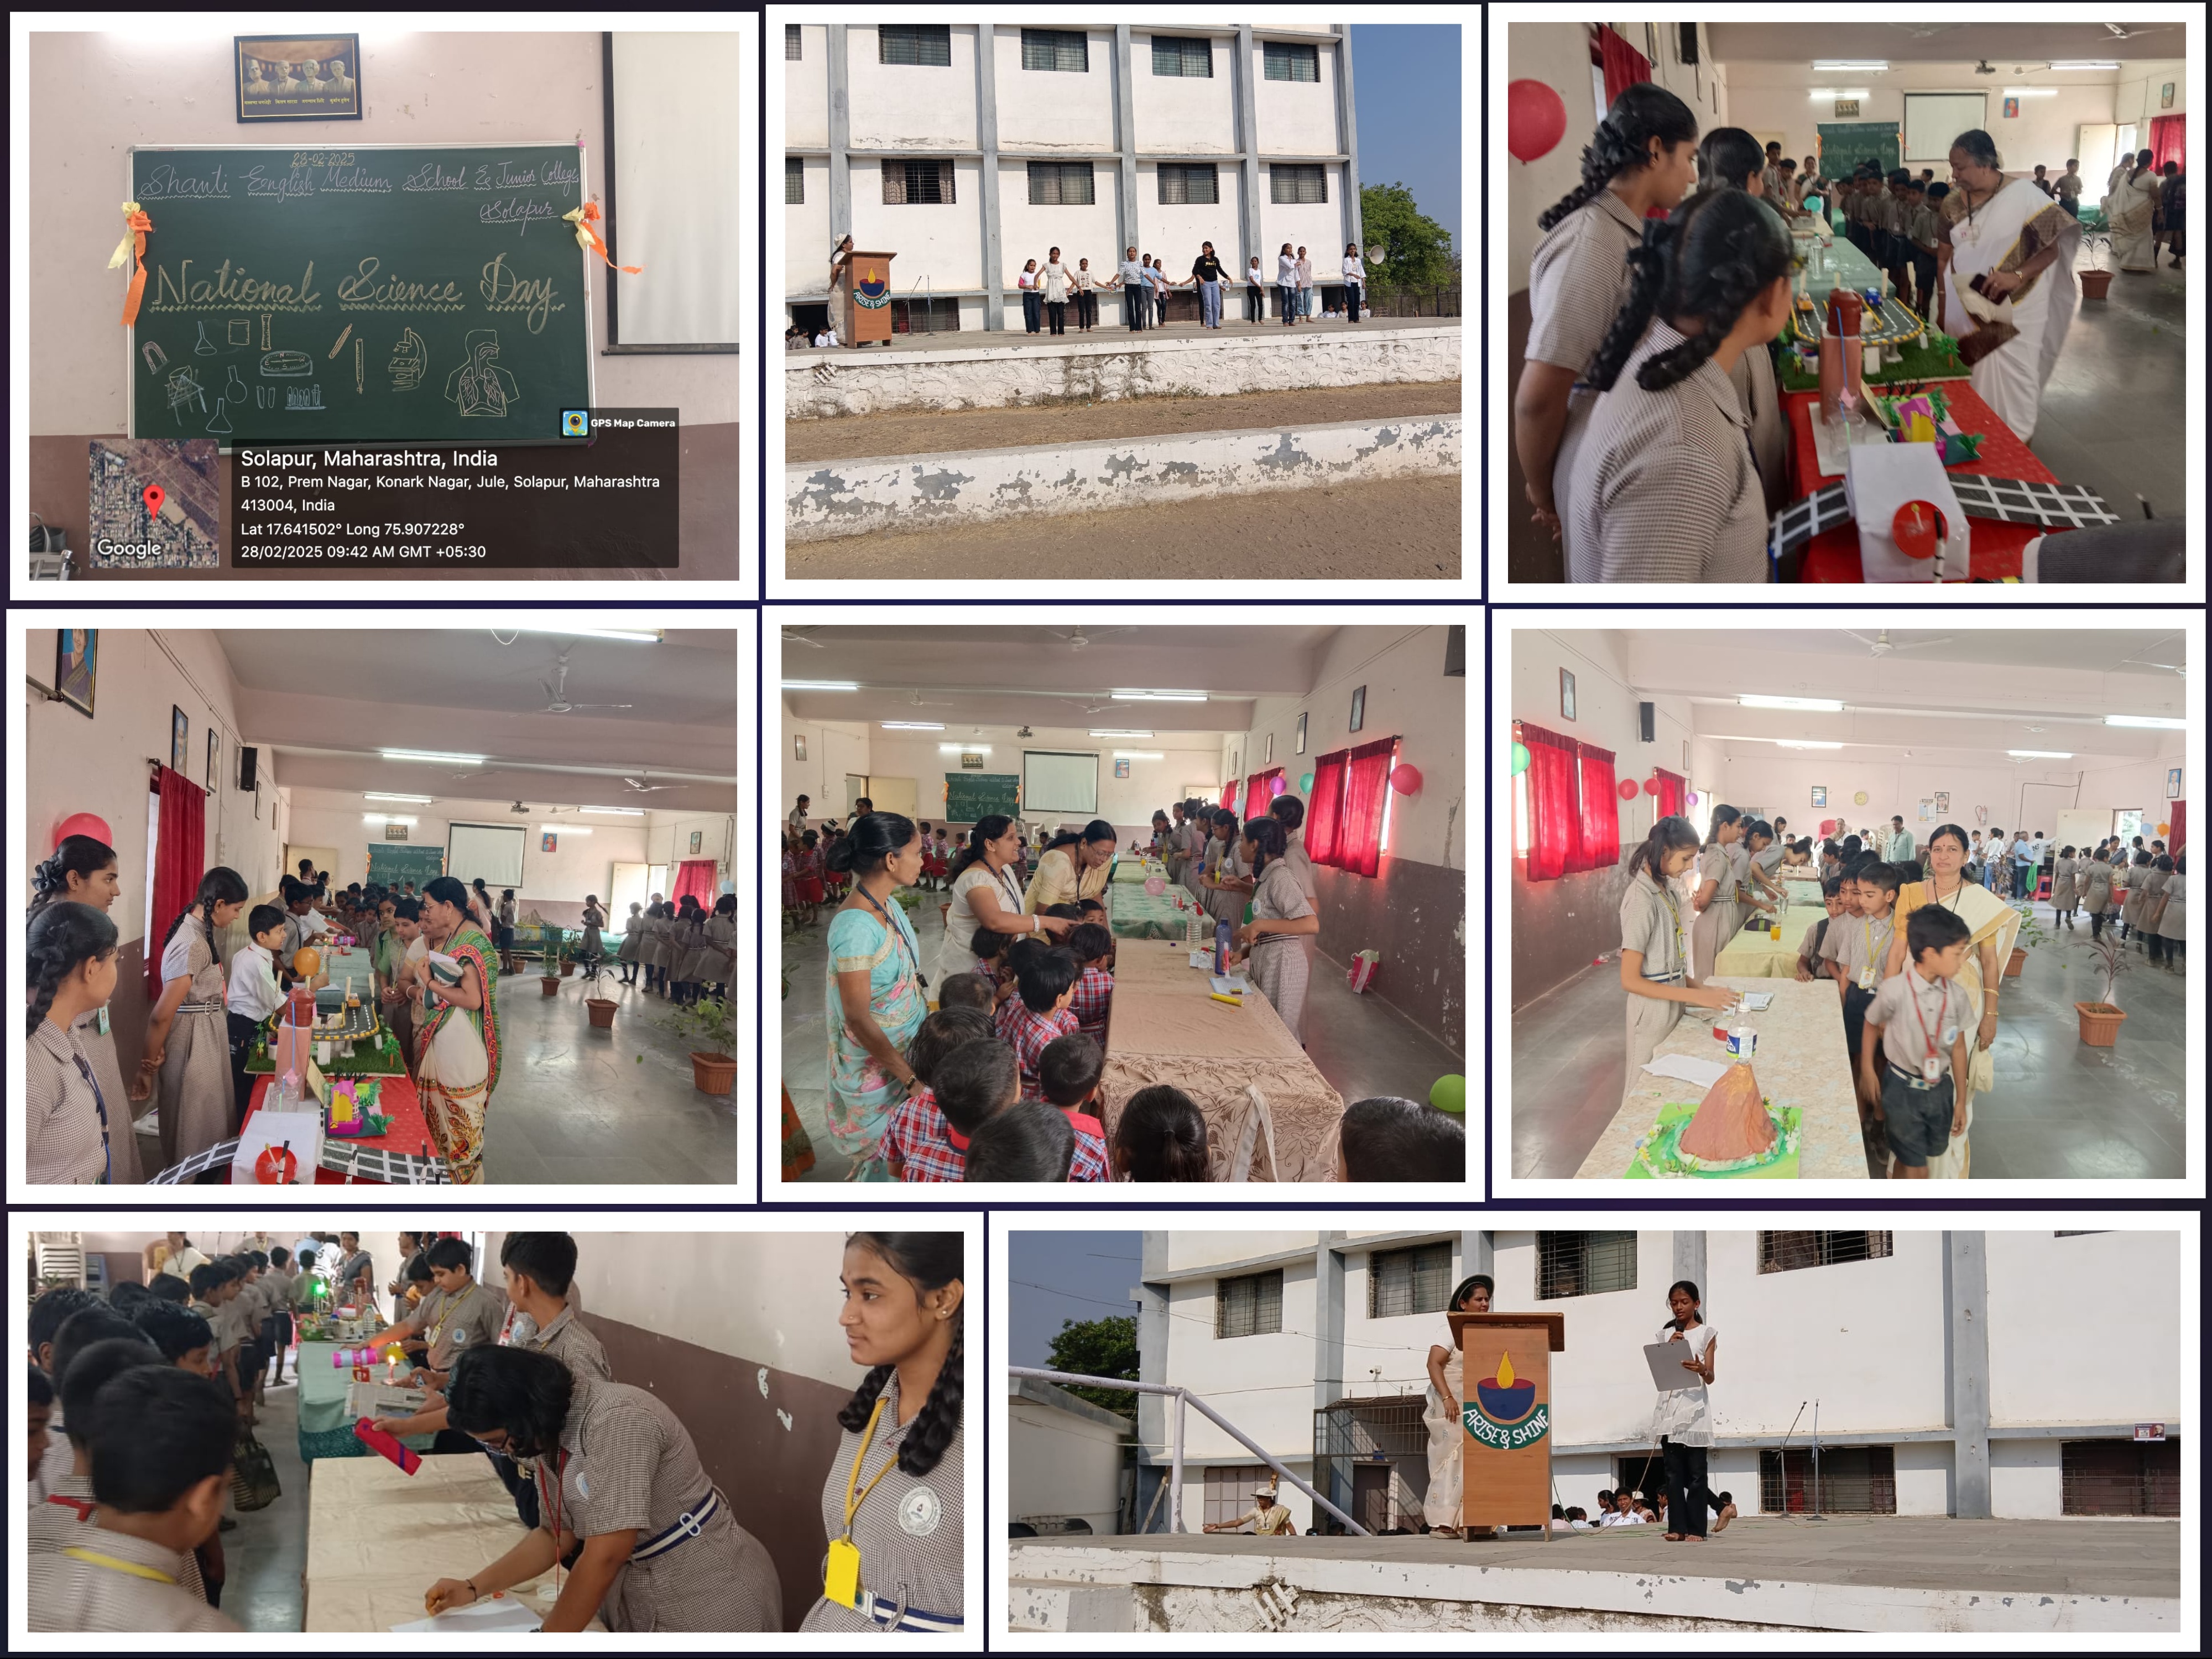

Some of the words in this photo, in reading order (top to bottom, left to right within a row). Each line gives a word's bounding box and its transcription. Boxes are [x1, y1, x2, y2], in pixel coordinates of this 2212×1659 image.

[291, 152, 355, 166] 28-02-2025
[137, 164, 228, 196] Shanti
[322, 166, 393, 189] Medium
[402, 163, 467, 189] School
[496, 161, 536, 185] Junior
[480, 198, 554, 236] Solapur
[152, 258, 320, 305] National
[338, 257, 462, 302] Science
[480, 252, 559, 334] Day
[853, 291, 870, 307] ARISE
[1463, 1408, 1501, 1444] ARISE
[1512, 1409, 1549, 1444] SHINE
